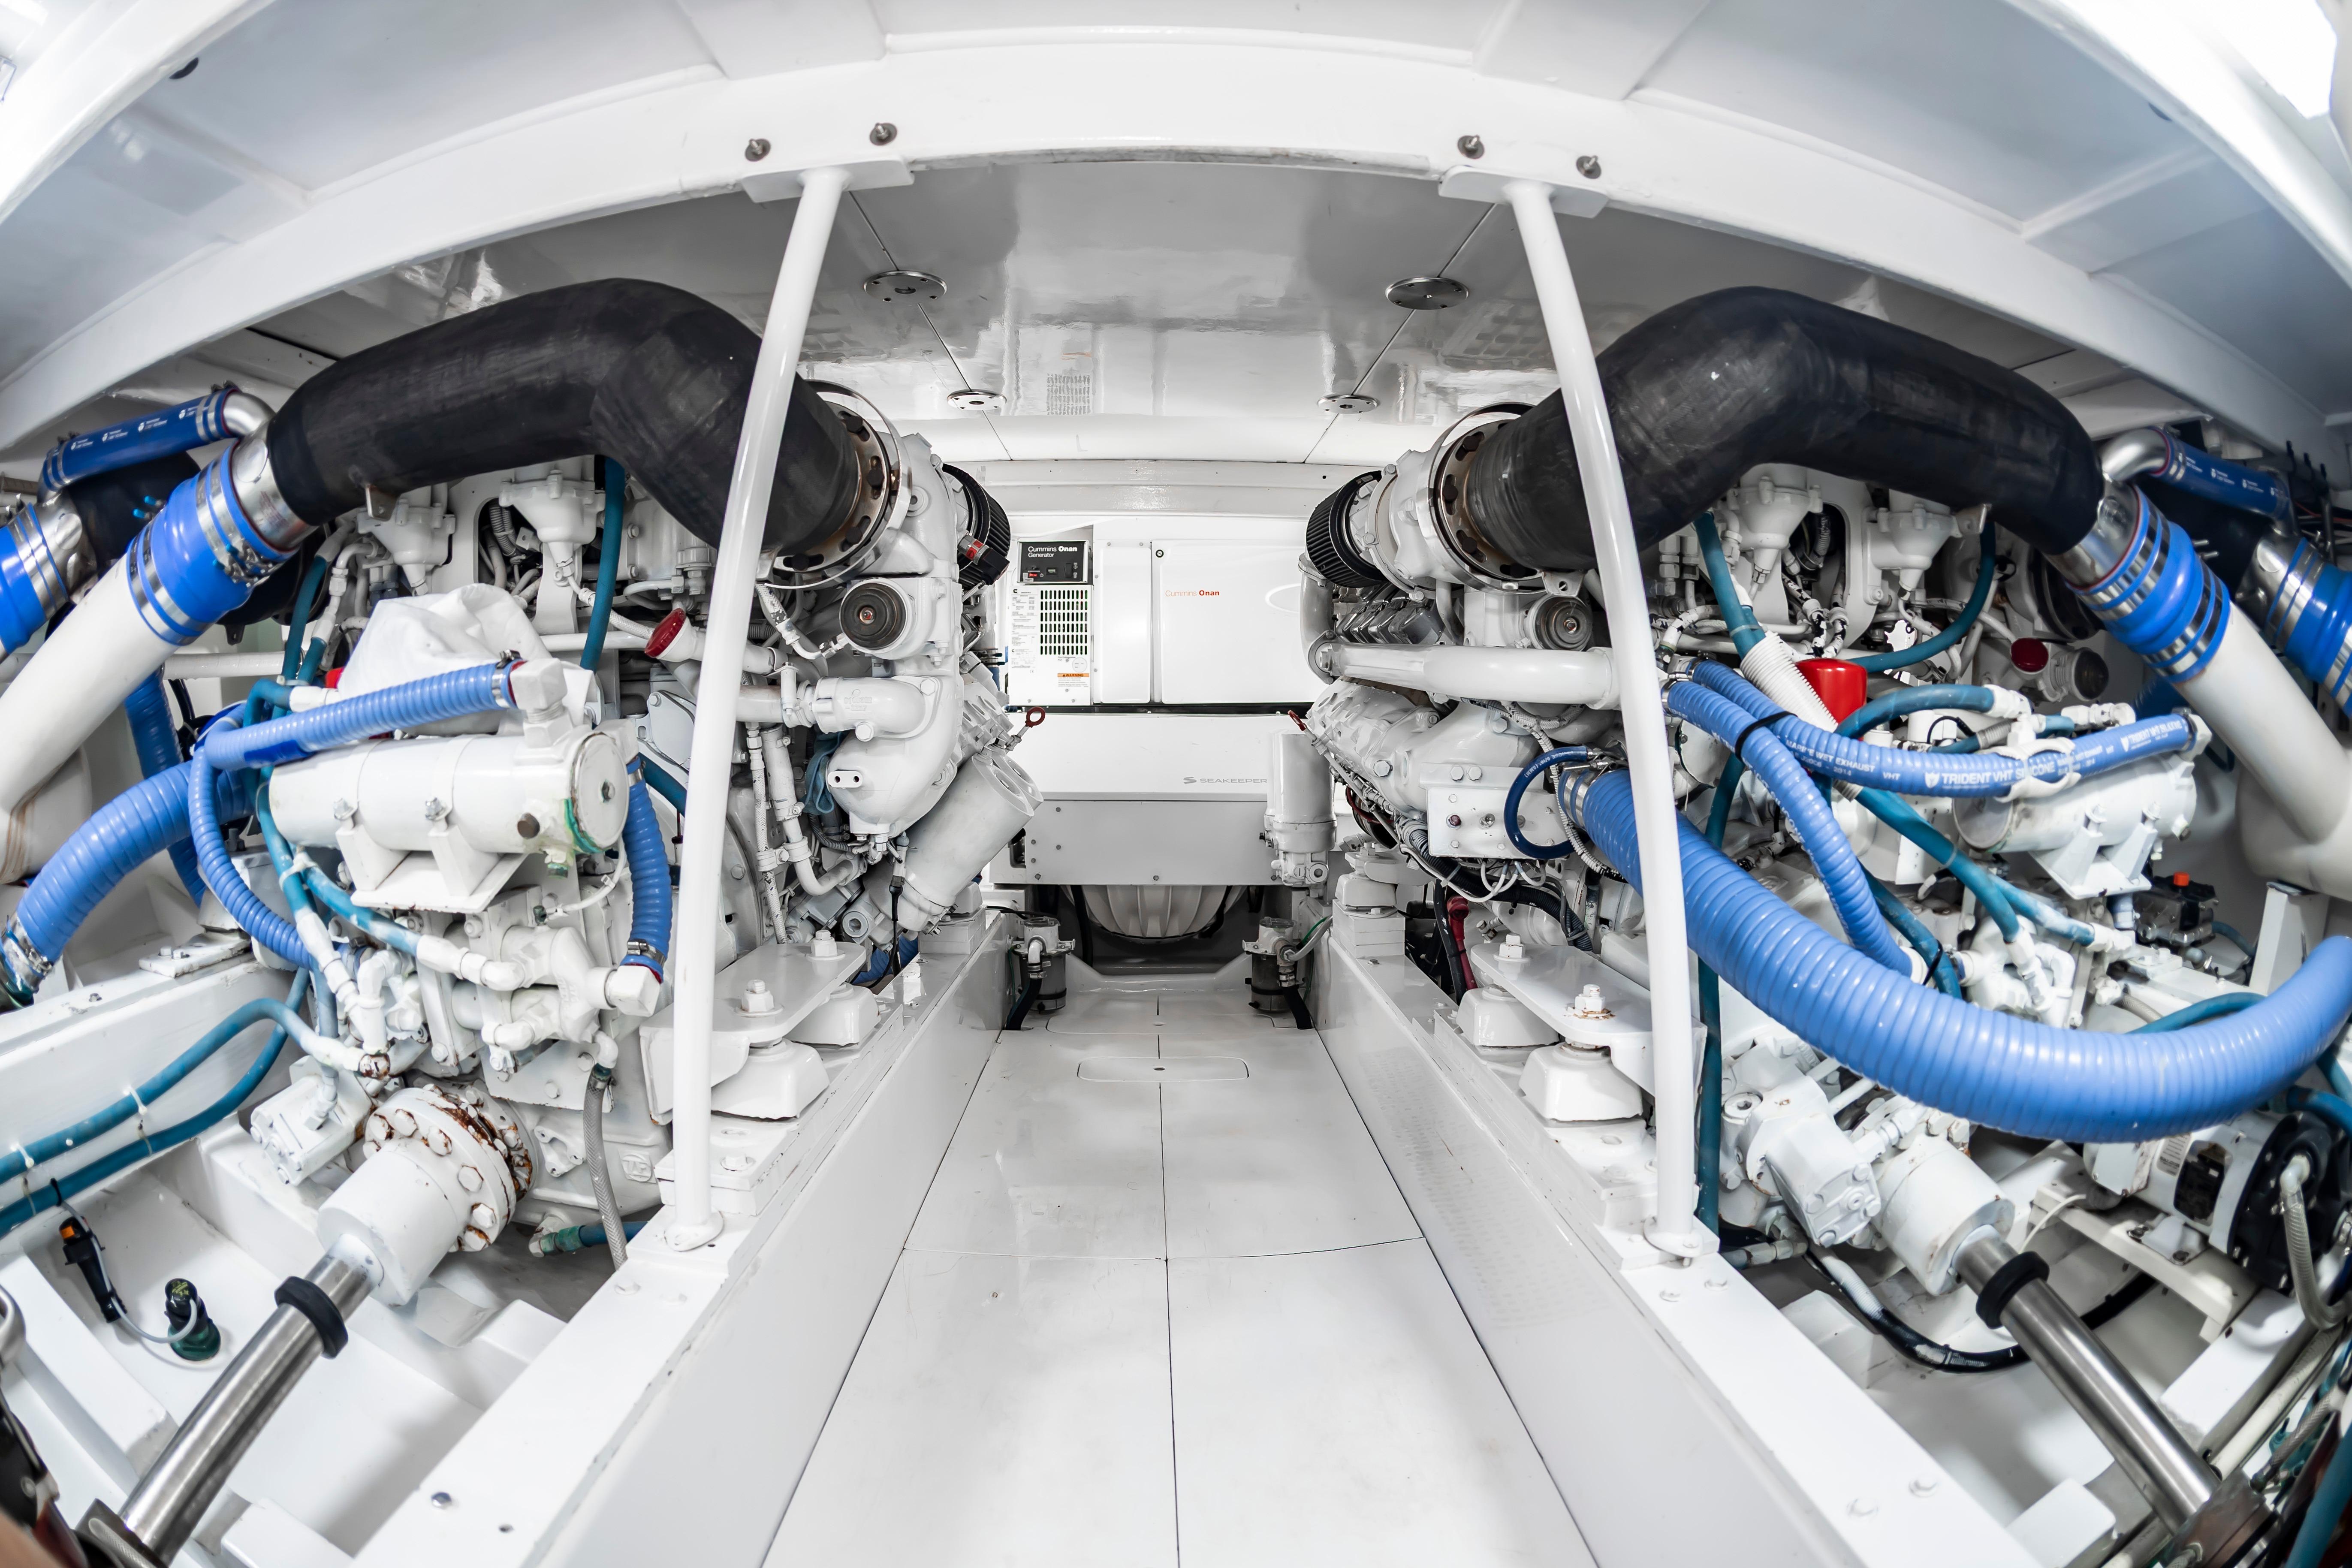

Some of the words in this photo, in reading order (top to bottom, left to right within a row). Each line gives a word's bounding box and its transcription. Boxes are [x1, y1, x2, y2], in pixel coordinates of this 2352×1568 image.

[1816, 751, 1834, 762] WET
[1835, 757, 1876, 772] EXHAUST
[1942, 772, 1992, 784] TRIDENT
[1993, 769, 2014, 782] VHT
[2016, 762, 2055, 781] SIICONE
